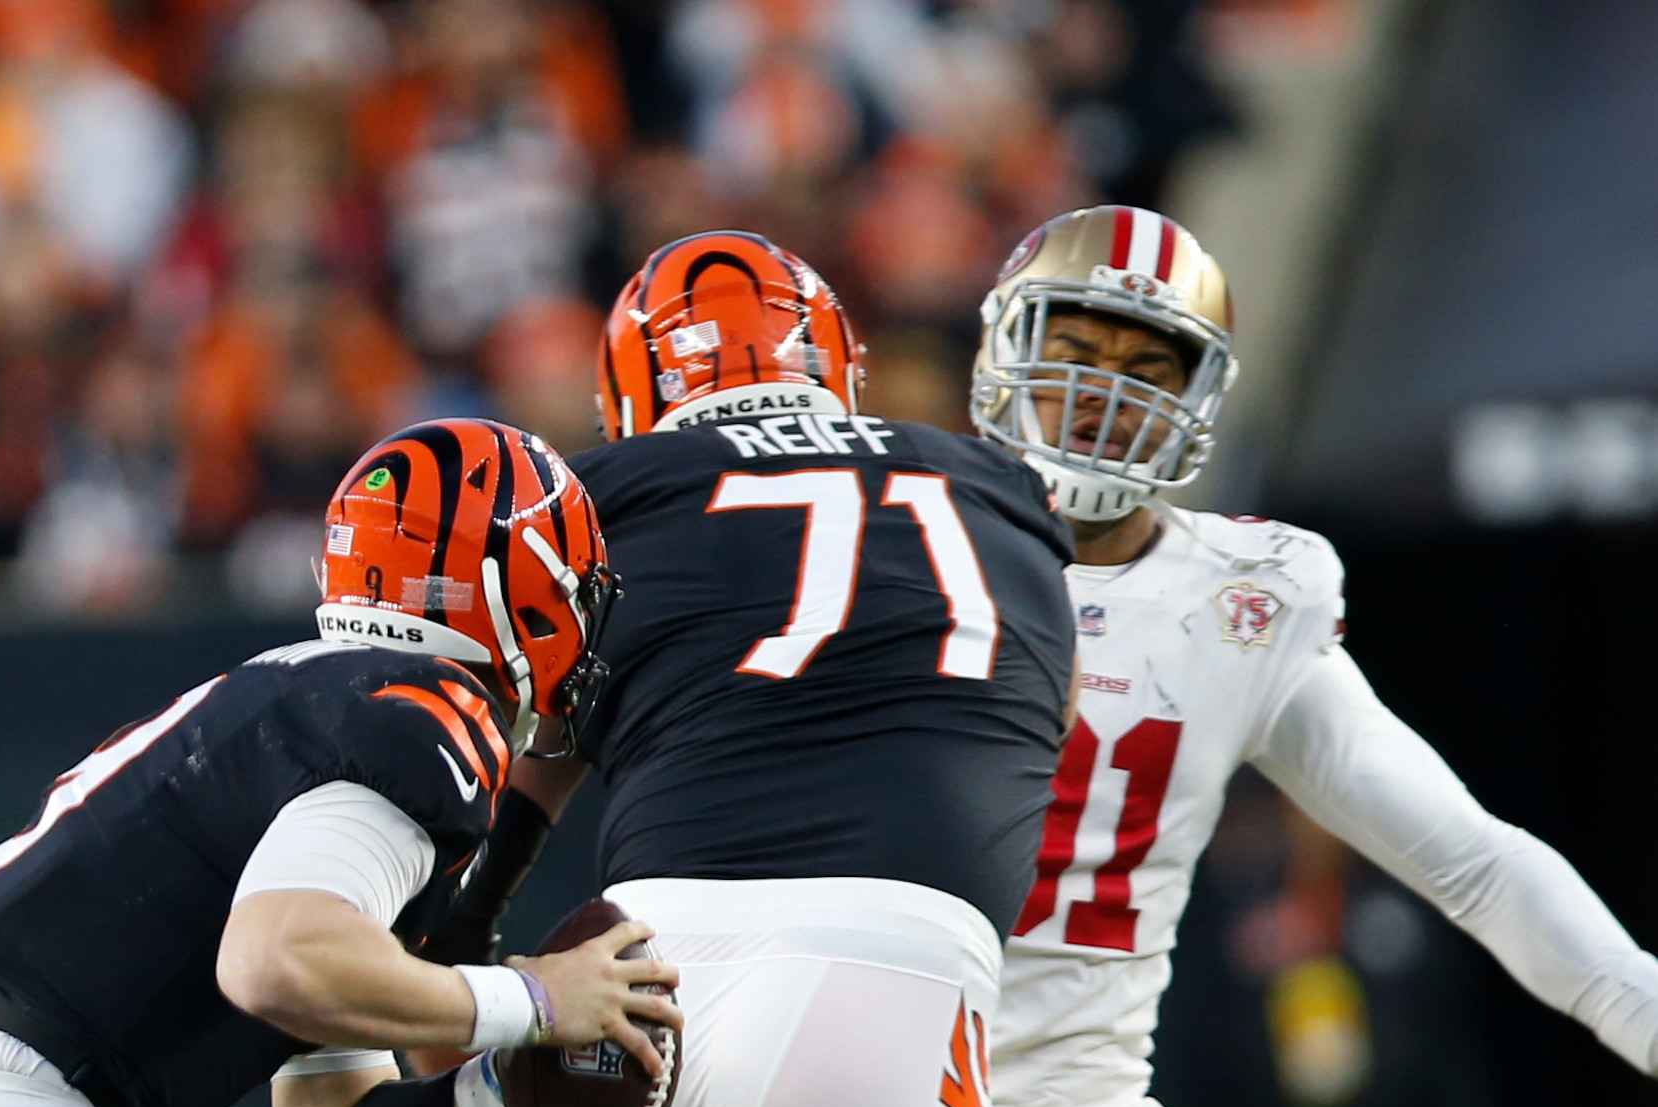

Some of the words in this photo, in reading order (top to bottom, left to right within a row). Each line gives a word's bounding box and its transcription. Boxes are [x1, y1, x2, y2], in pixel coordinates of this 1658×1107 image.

[716, 414, 894, 458] REIFF
[365, 565, 382, 603] 9
[704, 467, 1001, 680] 71
[1230, 594, 1269, 628] 75
